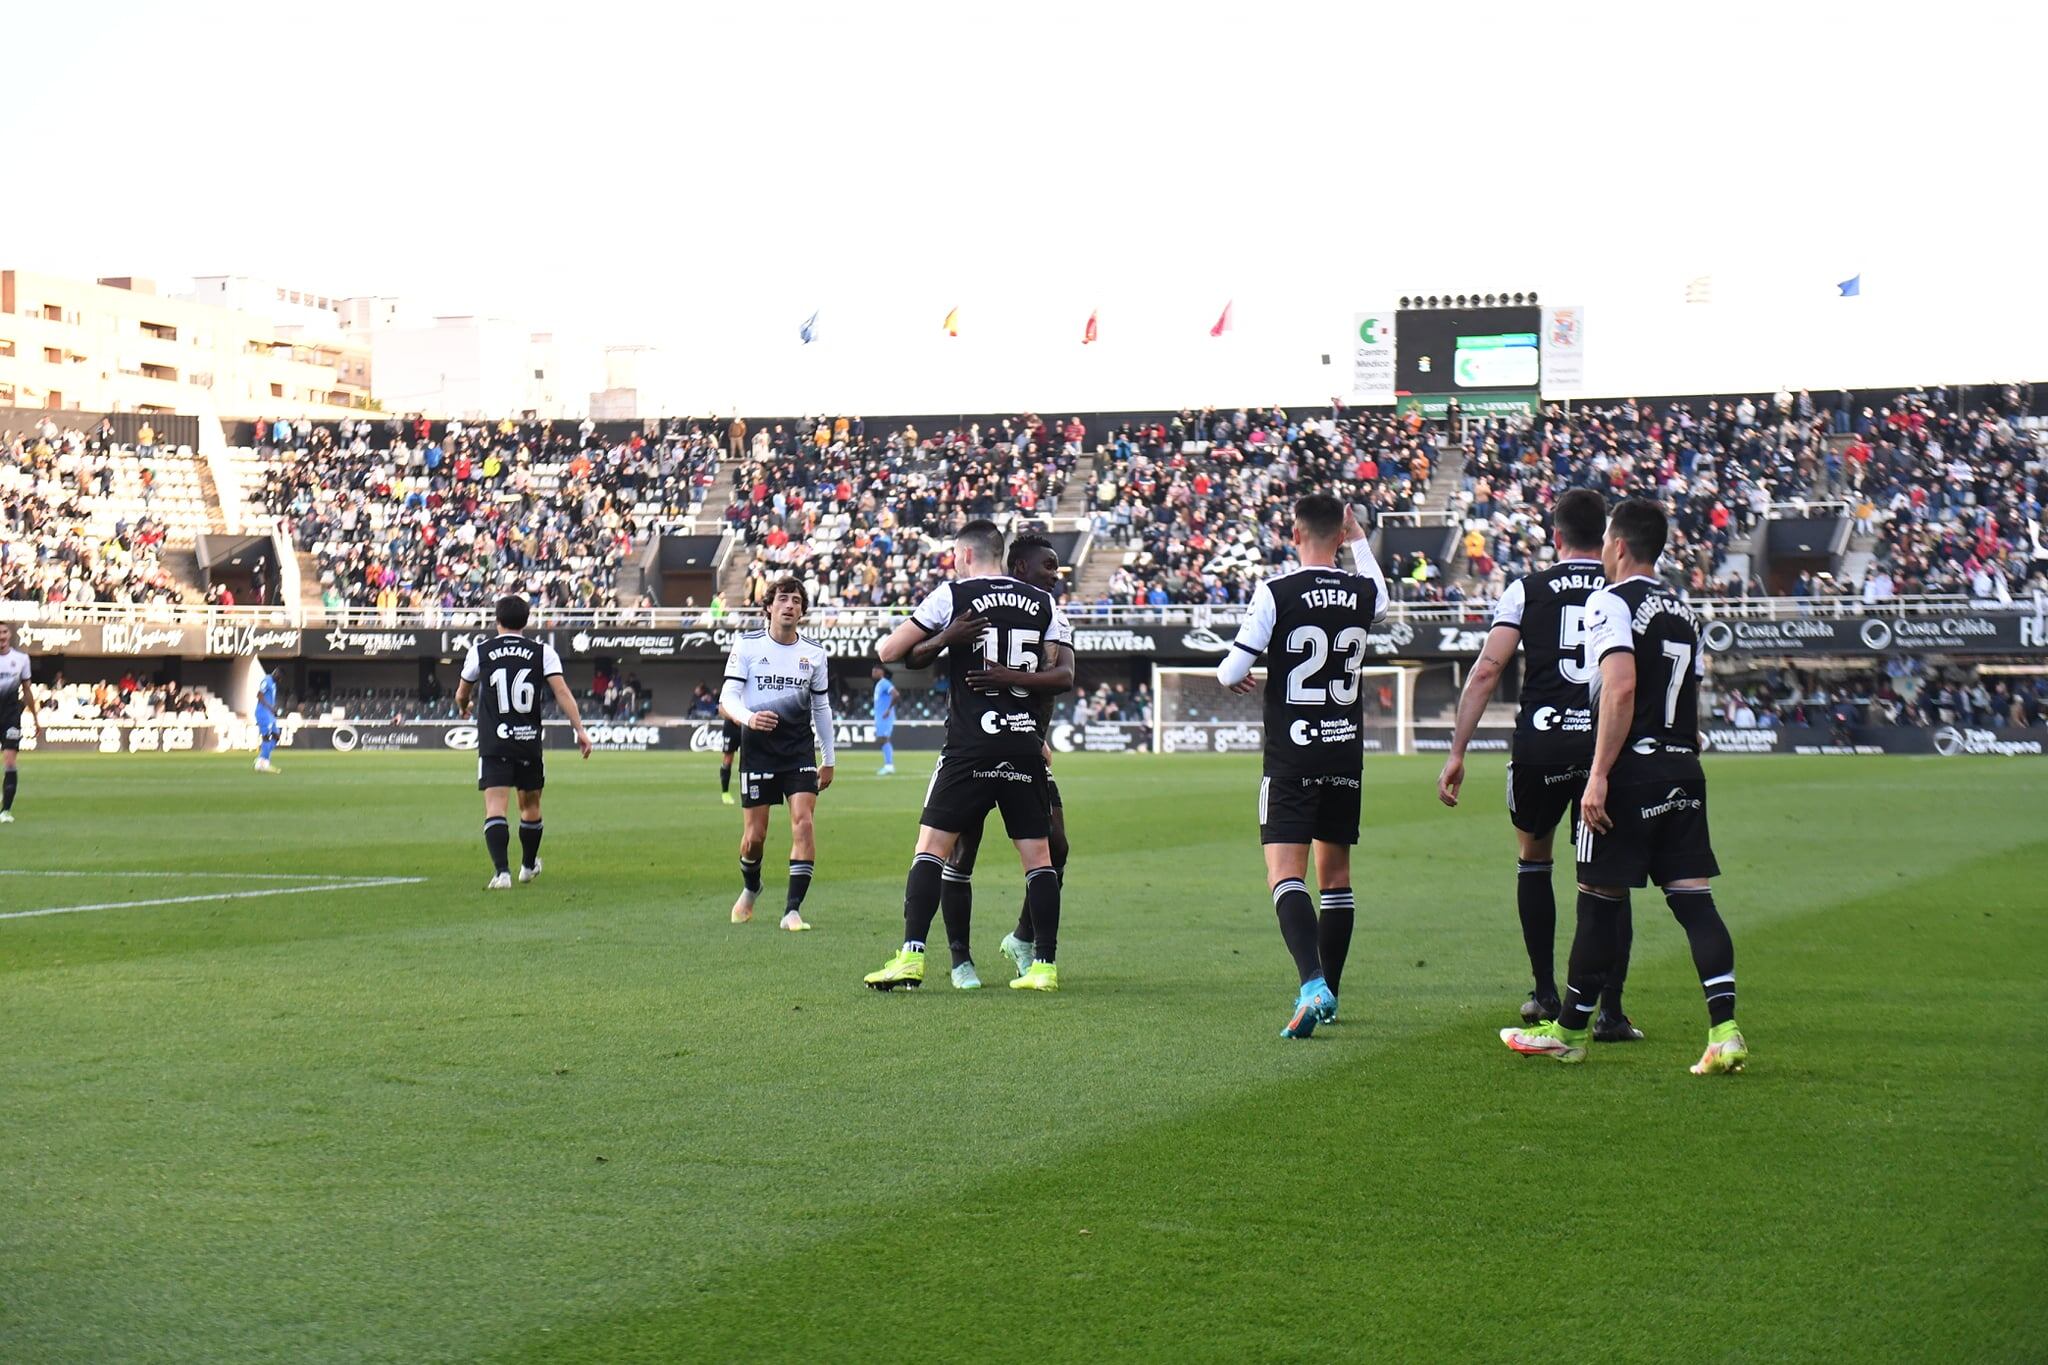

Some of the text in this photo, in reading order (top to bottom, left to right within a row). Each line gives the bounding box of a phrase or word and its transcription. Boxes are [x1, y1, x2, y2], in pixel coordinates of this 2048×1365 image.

[1548, 575, 1606, 593] PABLO
[971, 593, 1040, 616] DATKOVIĆ
[1301, 589, 1358, 610] TEJERA
[798, 627, 878, 640] MUDANZAS
[488, 646, 533, 661] OKAZAKI
[1558, 604, 1592, 684] 5
[973, 627, 1041, 698] 15
[1286, 625, 1367, 706] 23
[489, 668, 534, 714] 16
[1661, 639, 1691, 729] 7
[1320, 718, 1349, 728] hospital
[361, 733, 386, 745] Costa
[1322, 733, 1355, 742] cartagena
[973, 770, 1033, 783] inmohogares
